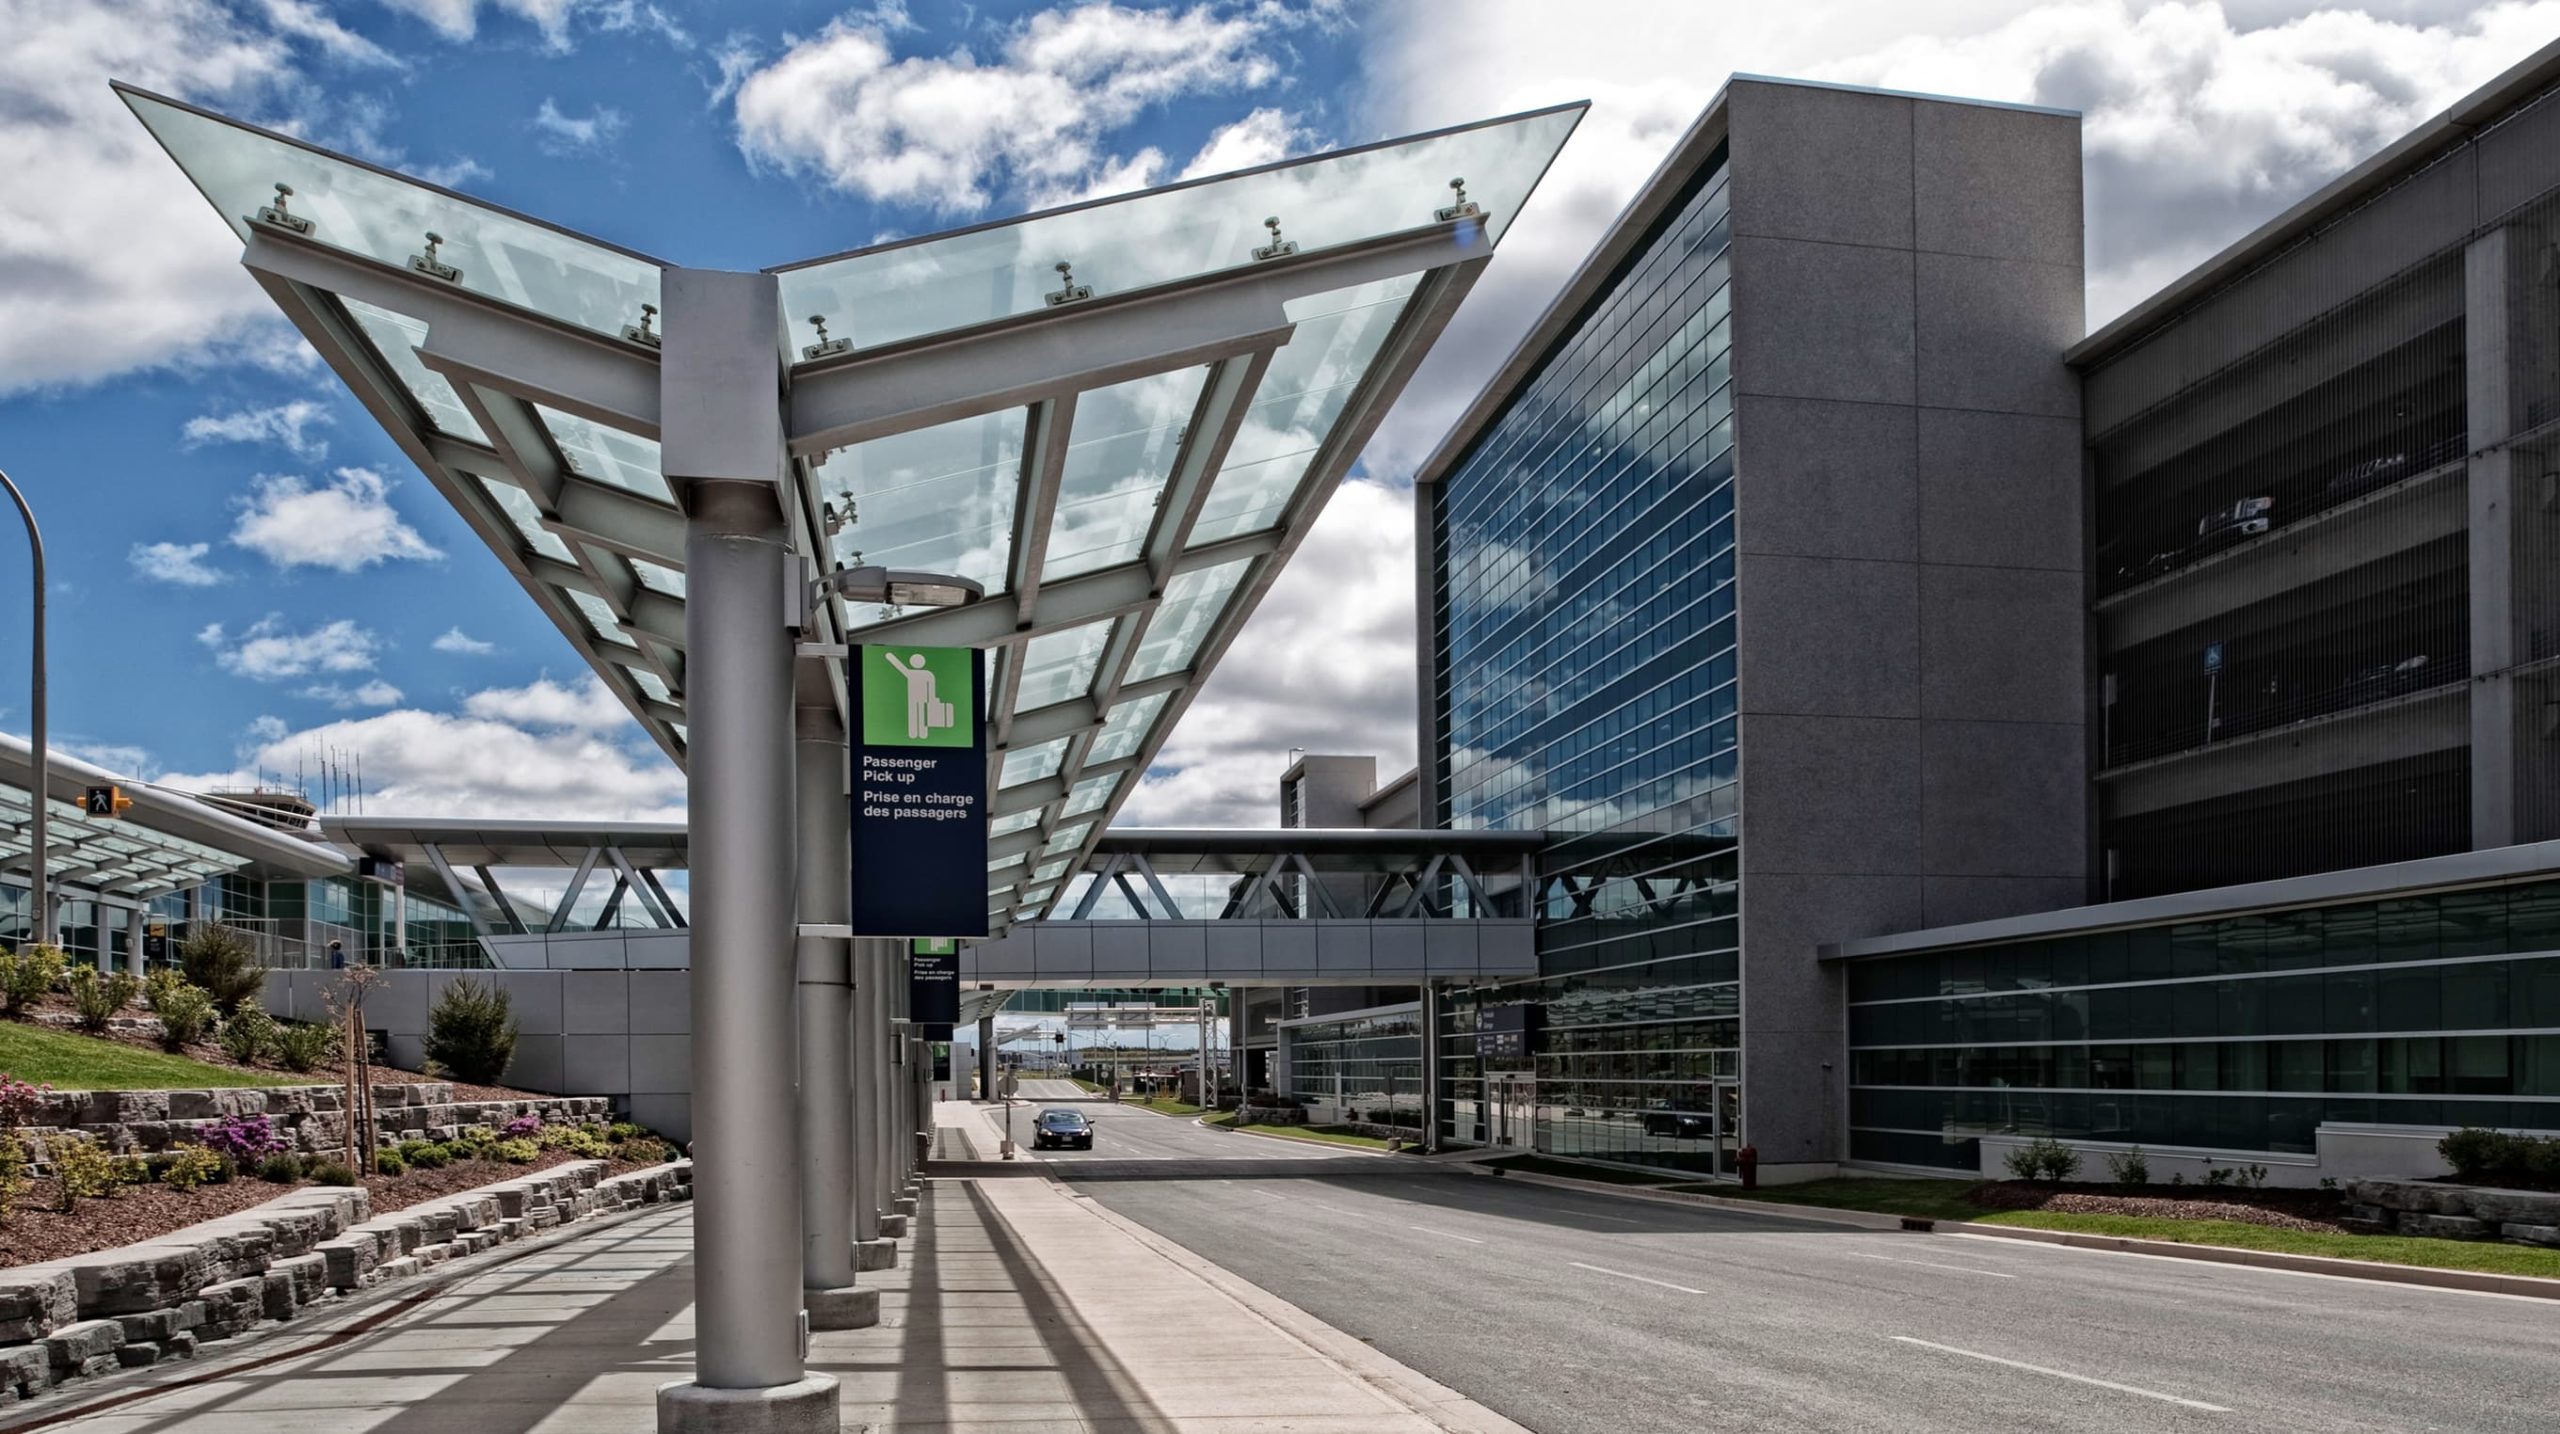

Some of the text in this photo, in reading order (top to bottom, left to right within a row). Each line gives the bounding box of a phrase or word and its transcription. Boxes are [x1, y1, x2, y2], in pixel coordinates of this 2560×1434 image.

[863, 755, 937, 771] Passenger
[863, 770, 915, 785] Pick up
[863, 791, 974, 807] Prise en charge
[863, 805, 967, 821] des passagers
